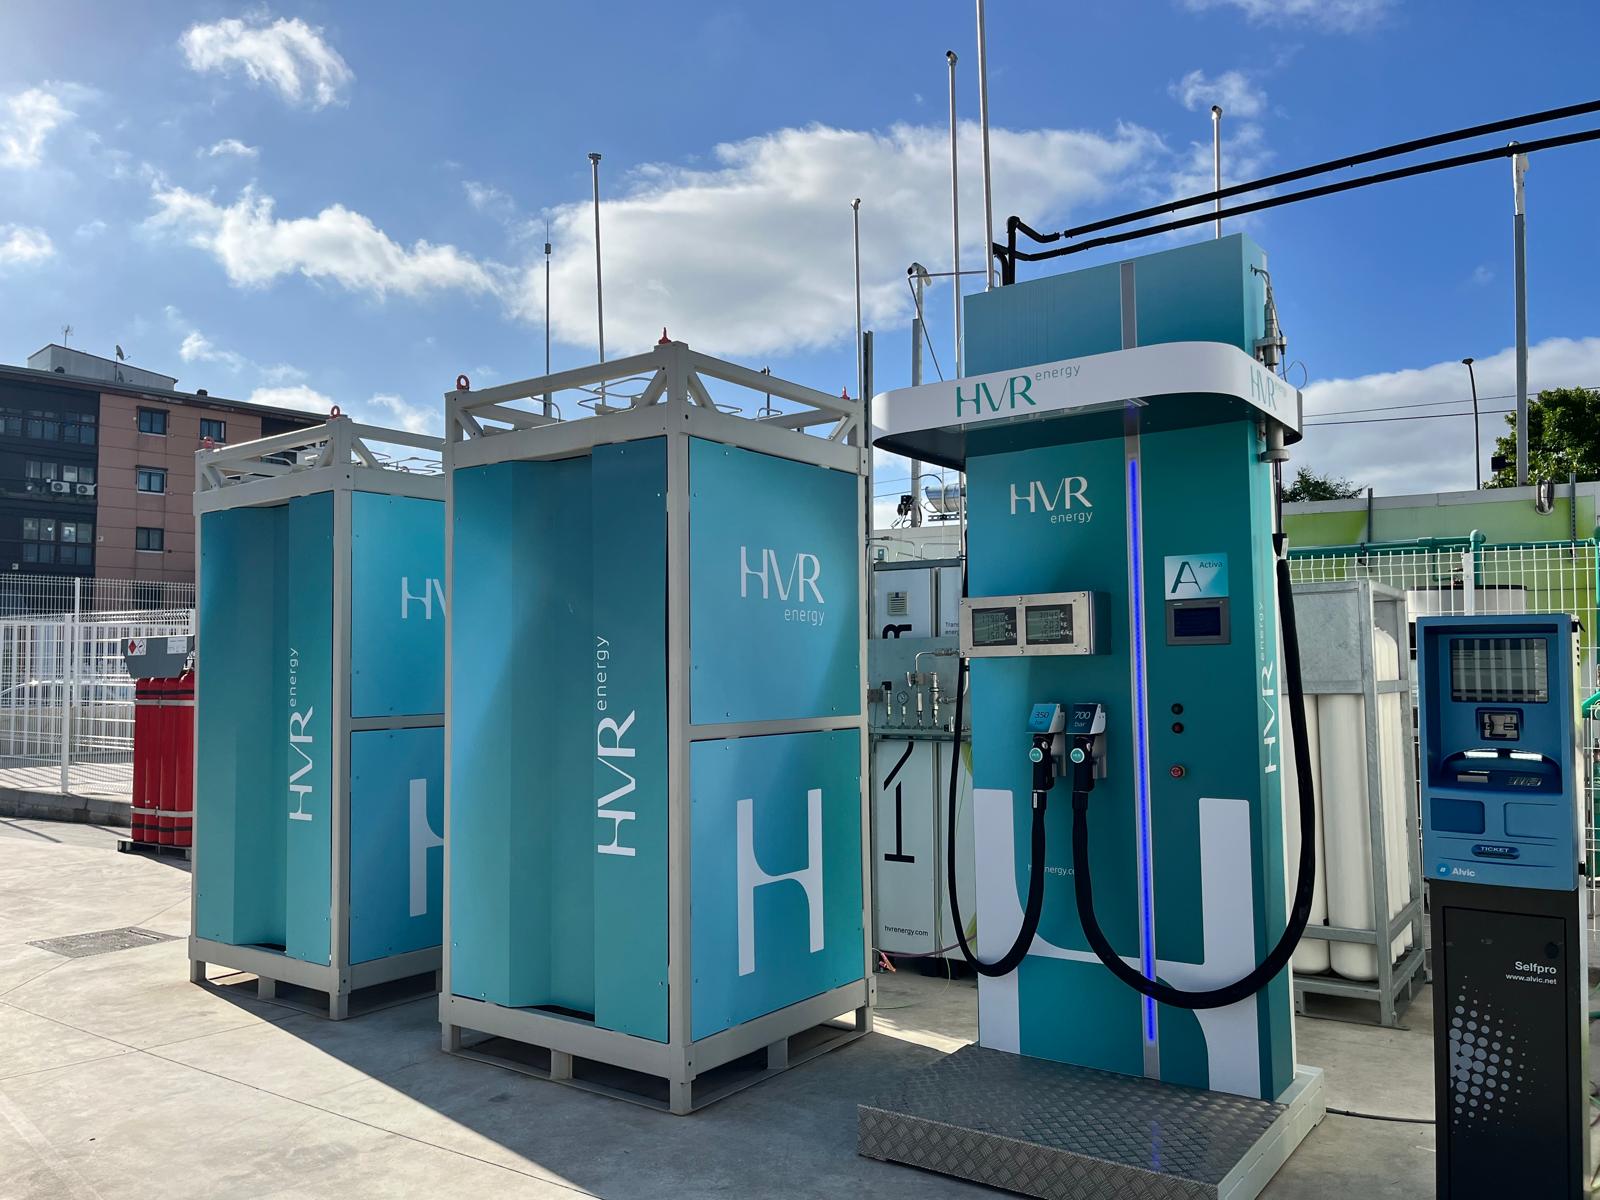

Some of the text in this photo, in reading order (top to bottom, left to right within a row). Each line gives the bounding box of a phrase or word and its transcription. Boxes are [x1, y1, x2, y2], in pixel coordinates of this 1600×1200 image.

[956, 365, 1081, 417] HVR energy
[1250, 365, 1277, 411] HVR
[1010, 476, 1093, 515] HVR
[1050, 511, 1093, 524] energy
[740, 545, 825, 604] HVR
[1170, 561, 1202, 594] A
[1199, 560, 1223, 569] Activa
[401, 576, 446, 620] HV
[784, 608, 825, 626] energy
[1074, 711, 1091, 720] 700
[1261, 660, 1277, 774] HVR
[289, 647, 313, 821] HVR energy
[596, 636, 636, 857] HVR energy
[737, 788, 824, 977] H
[1452, 867, 1476, 877] Alvic
[884, 924, 929, 937] hvrenergy.com
[1505, 973, 1557, 985] www.alvic.net
[1514, 961, 1557, 975] Selfpro
